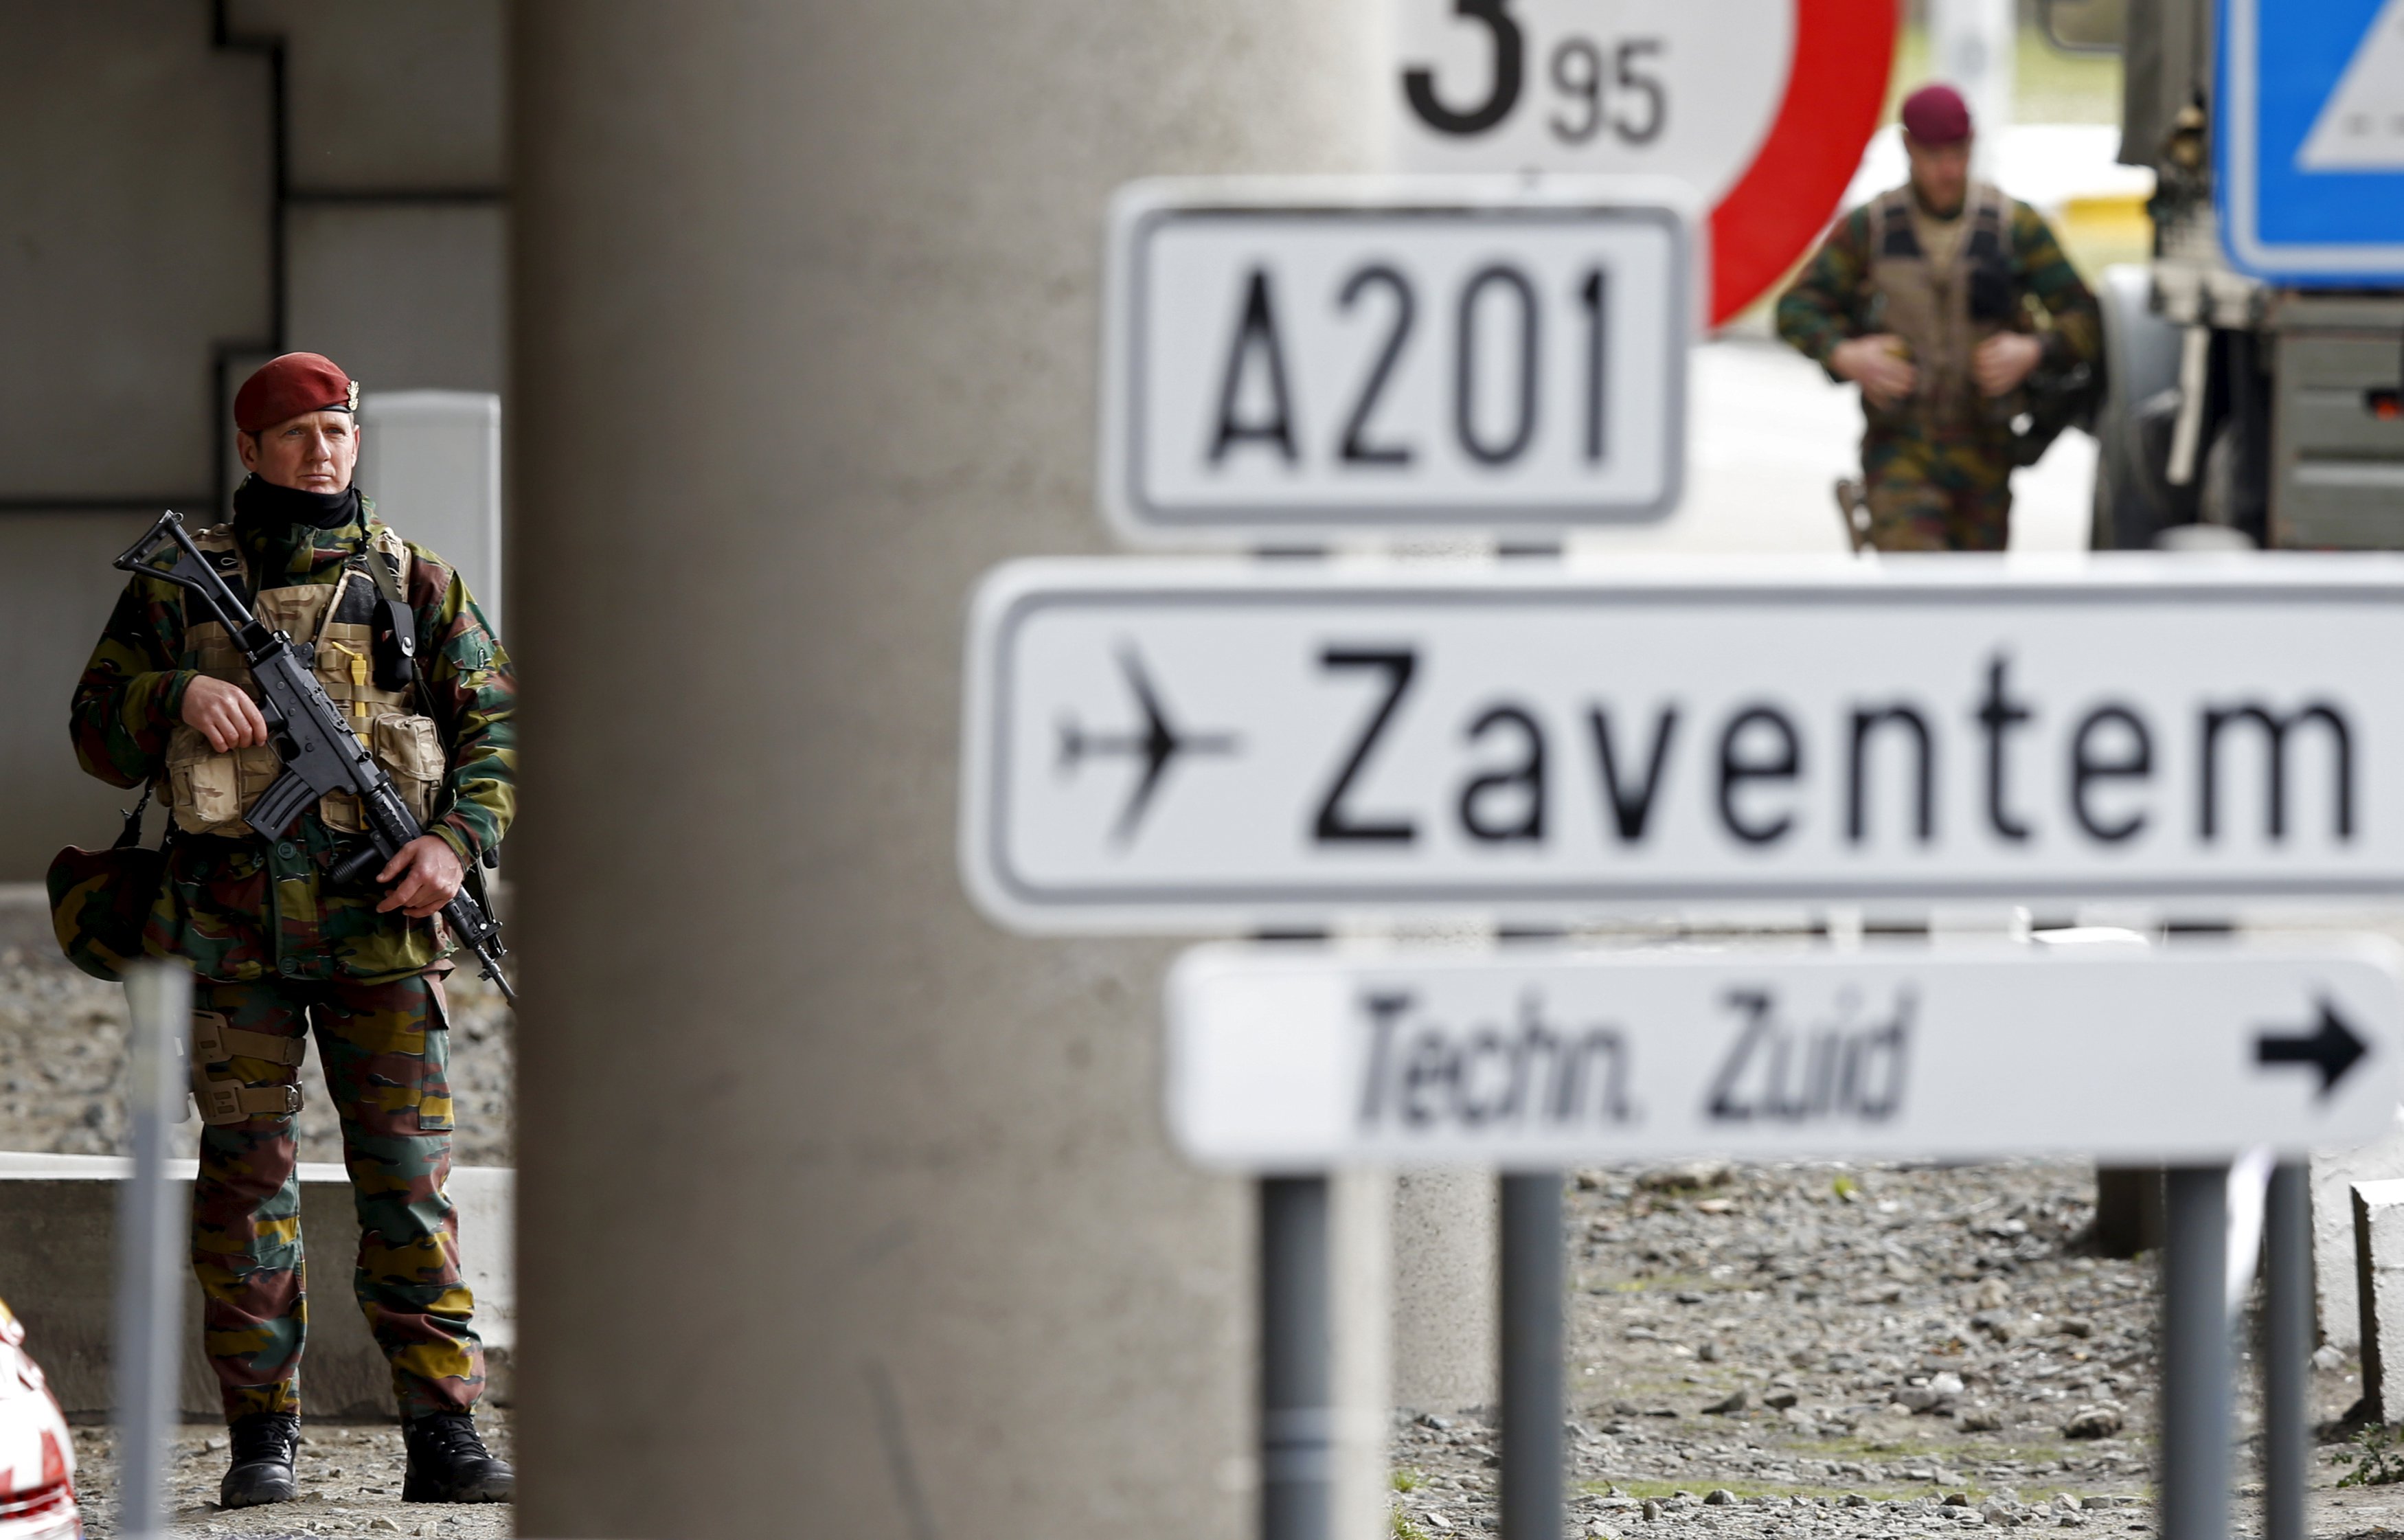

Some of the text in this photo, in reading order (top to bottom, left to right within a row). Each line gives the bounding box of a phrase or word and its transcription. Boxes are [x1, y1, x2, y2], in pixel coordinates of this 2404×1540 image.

[1207, 261, 1609, 470] A201
[1311, 644, 2359, 848] Zaventem
[1705, 985, 1918, 1122] Zuid
